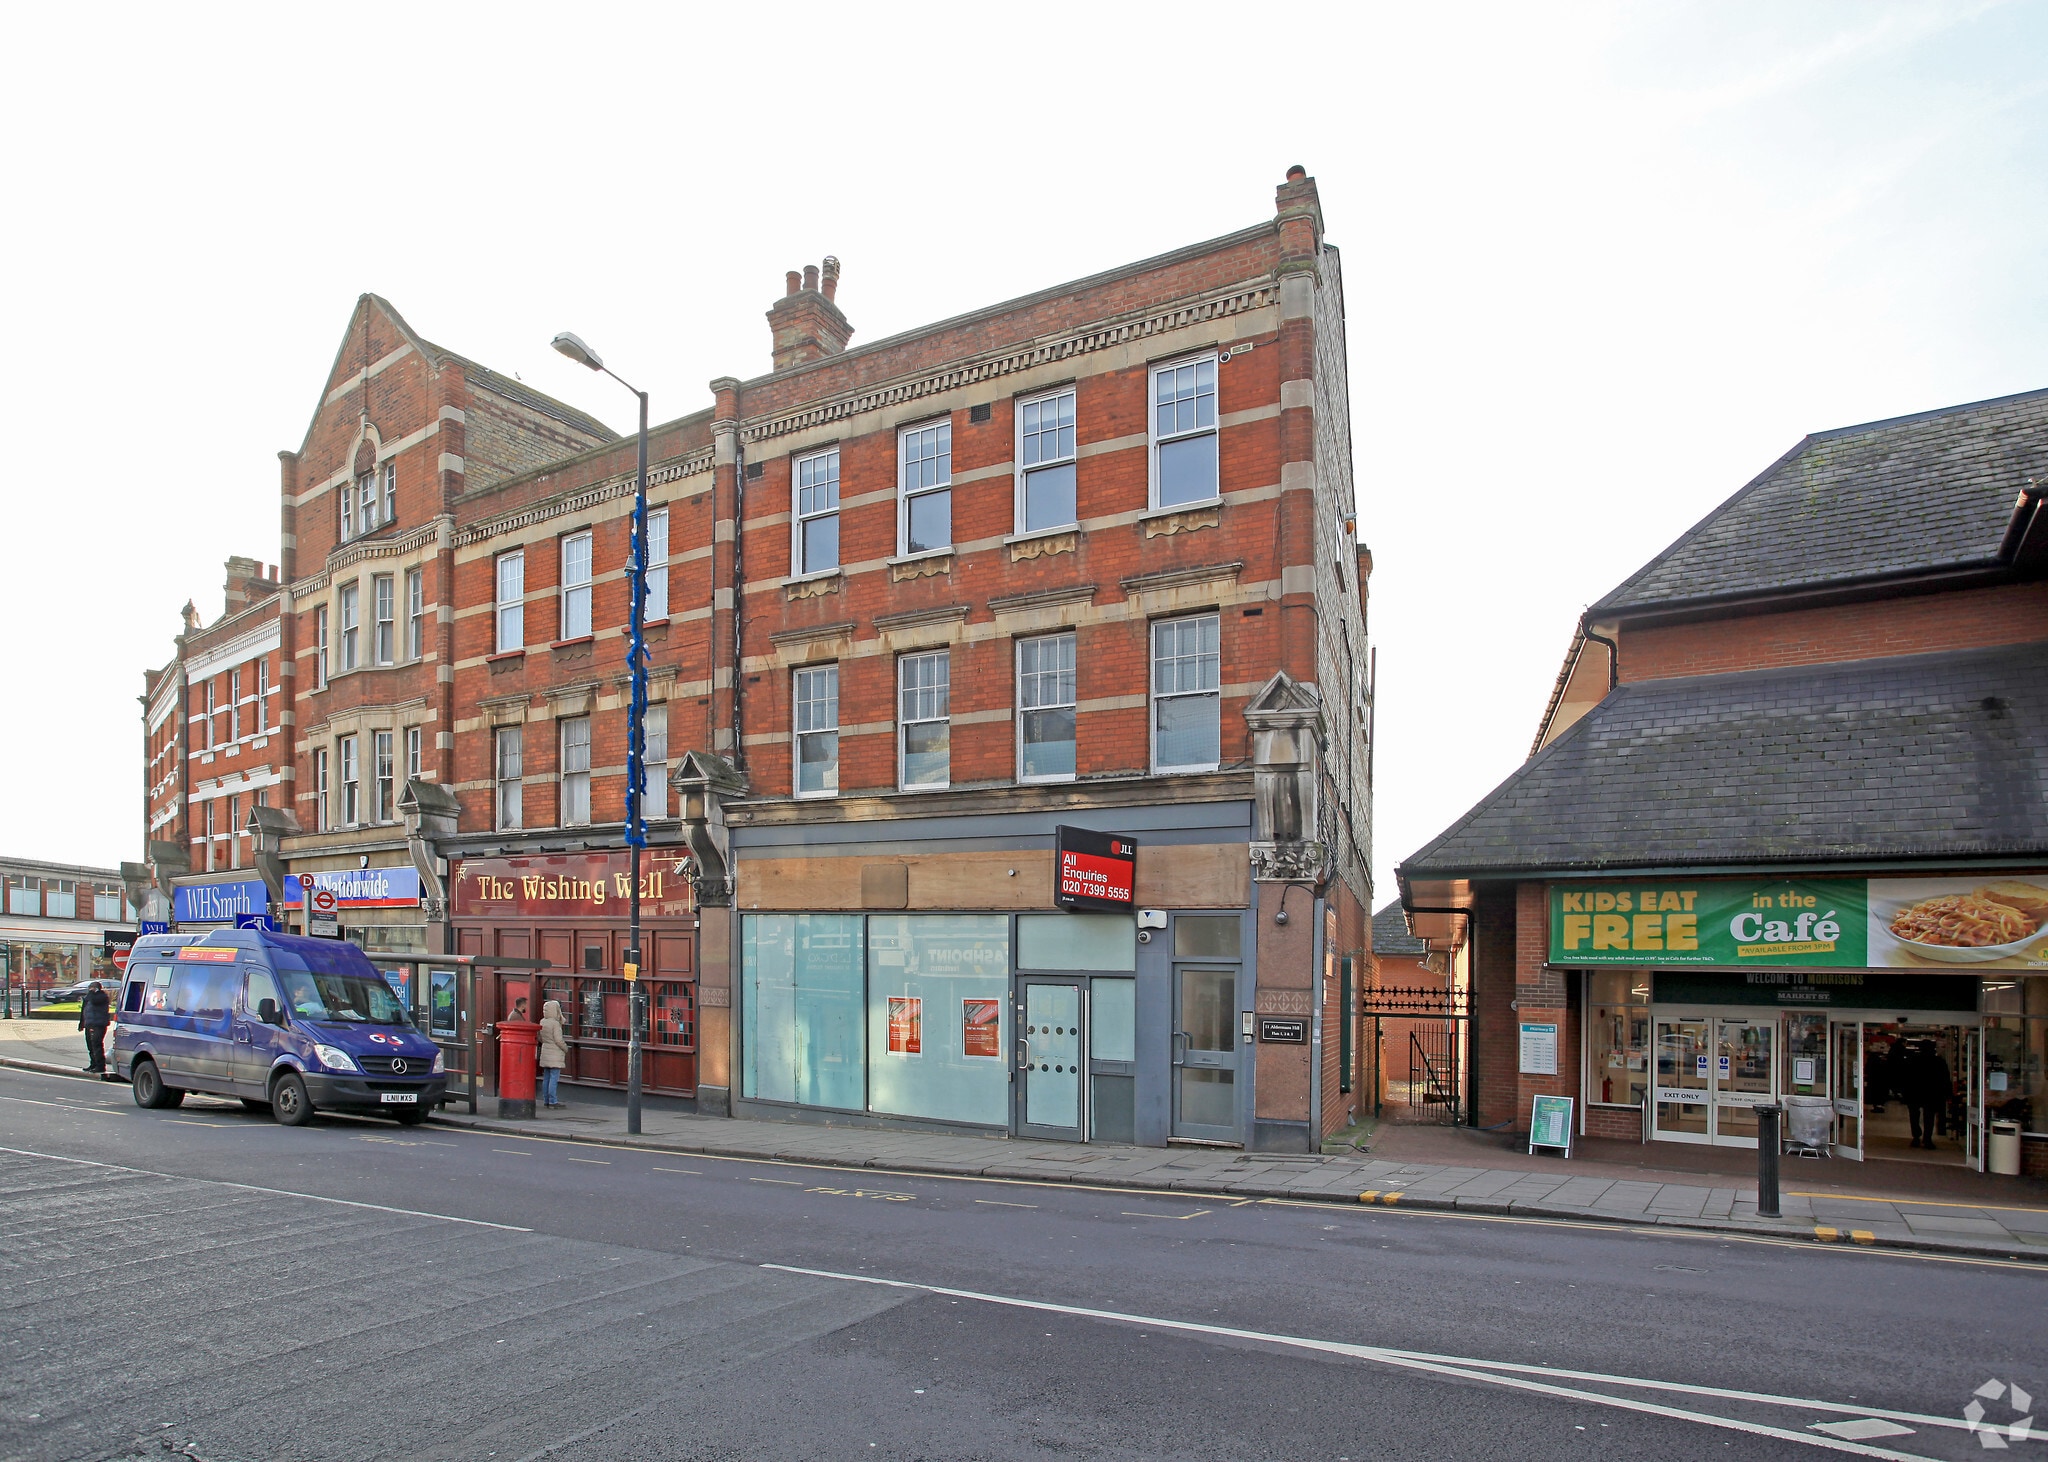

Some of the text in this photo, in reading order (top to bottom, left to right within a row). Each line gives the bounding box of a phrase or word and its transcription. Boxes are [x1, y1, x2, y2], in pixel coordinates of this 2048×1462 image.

[1120, 844, 1133, 855] JLL
[1063, 853, 1077, 866] All
[303, 876, 312, 886] D
[1063, 866, 1108, 883] Enquiries
[321, 872, 389, 898] Nationwide
[477, 871, 664, 905] The Wishing Well
[1062, 880, 1129, 900] 020 7399 5555
[186, 884, 250, 919] WHSmith
[1562, 890, 1698, 912] KIDS EAT
[1752, 890, 1816, 908] in the
[1563, 914, 1698, 950] FREE
[1730, 910, 1840, 942] Café
[1788, 944, 1812, 952] FROM
[1746, 973, 1864, 985] WELCOME TO MORRISONS
[1777, 992, 1817, 1000] MARKET
[369, 1033, 404, 1046] G4S
